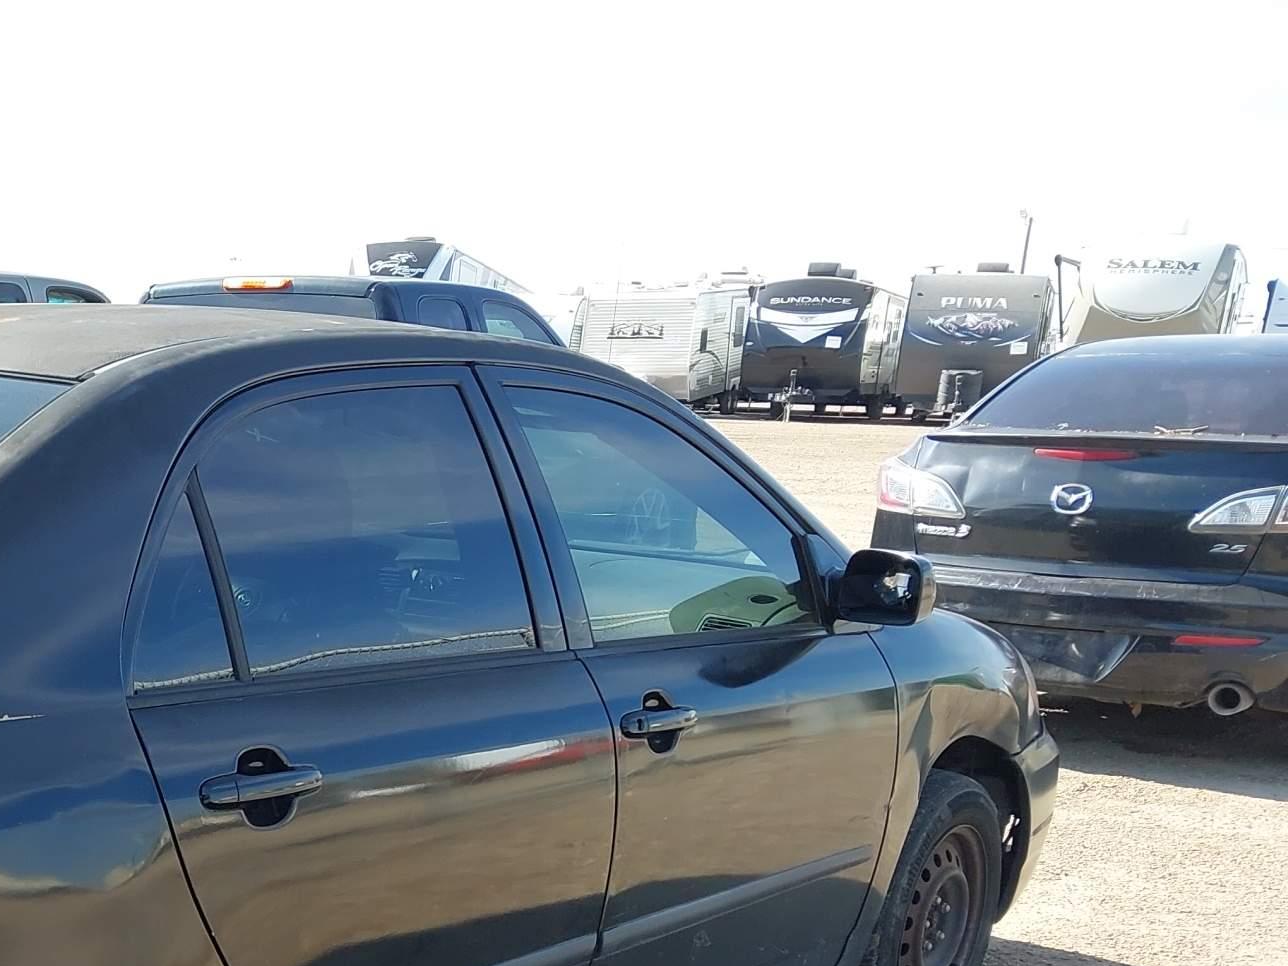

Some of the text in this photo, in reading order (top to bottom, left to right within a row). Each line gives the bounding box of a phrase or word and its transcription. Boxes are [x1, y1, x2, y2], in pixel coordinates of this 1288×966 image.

[1107, 258, 1201, 271] SALEM
[769, 296, 852, 305] SUNDANCE
[940, 296, 1008, 310] PUMA
